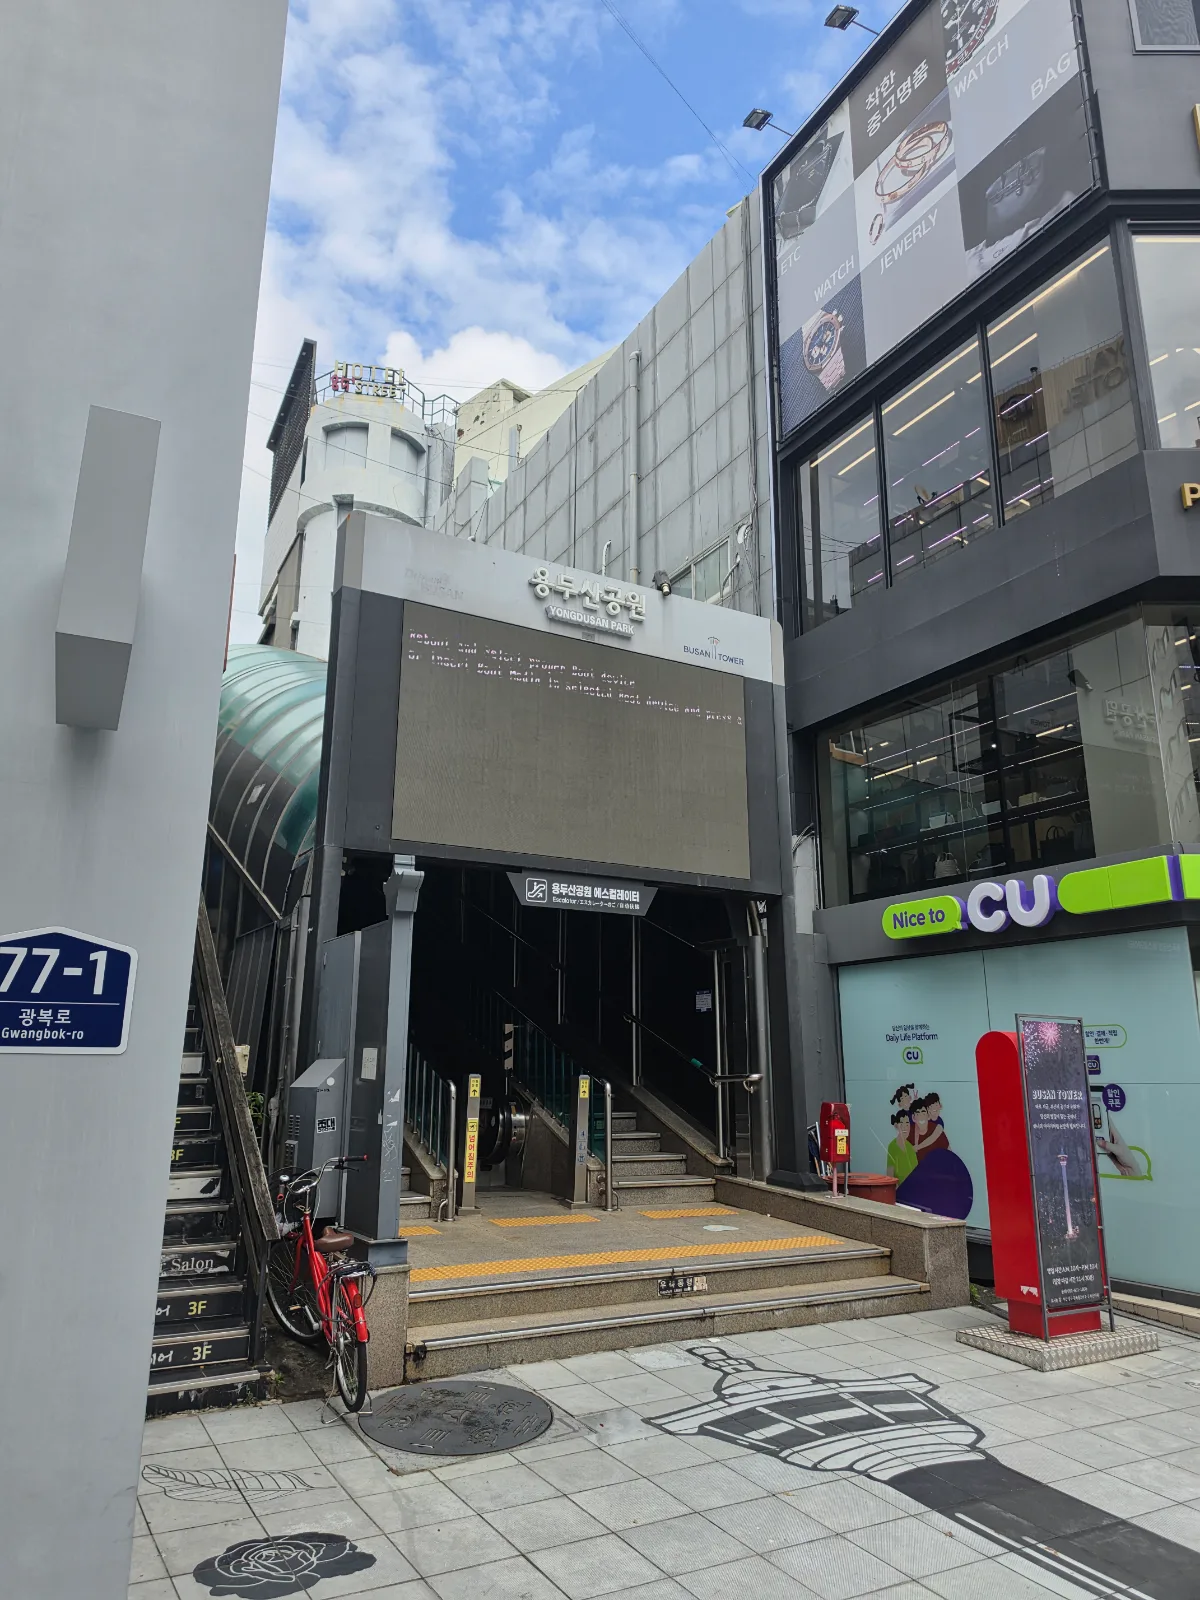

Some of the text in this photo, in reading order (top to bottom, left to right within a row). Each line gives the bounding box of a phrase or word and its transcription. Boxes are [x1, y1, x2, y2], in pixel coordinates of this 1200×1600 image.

[954, 33, 1009, 98] WATCH
[1031, 52, 1071, 100] BAG
[866, 69, 896, 110] 착한
[867, 59, 929, 137] 중고명품
[880, 208, 938, 275] JEWERLY
[780, 245, 802, 276] ETC
[813, 254, 855, 302] WATCH
[334, 360, 405, 385] HOTEL
[355, 381, 406, 399] STREET
[528, 567, 646, 622] 용두산공원
[548, 605, 636, 635] YONGDUSAN PARK
[683, 645, 744, 665] BUSAN TOWER
[552, 883, 640, 902] 용두산공원 에스컬레이터
[893, 875, 1051, 932] Nice to CU
[0, 946, 108, 995] 77-1
[19, 1008, 71, 1027] 광복로
[1, 1027, 84, 1041] Gwangbok-ro
[886, 1032, 938, 1043] Daily Life Platform
[906, 1051, 919, 1060] CU
[1033, 1089, 1083, 1100] BUSAN TOWER
[1107, 1089, 1120, 1098] 할인
[1108, 1098, 1121, 1107] 쿠폰
[466, 1134, 476, 1179] 넘어짐주의
[172, 1257, 214, 1271] Salon
[188, 1301, 207, 1315] 3F
[192, 1345, 212, 1361] 3F
